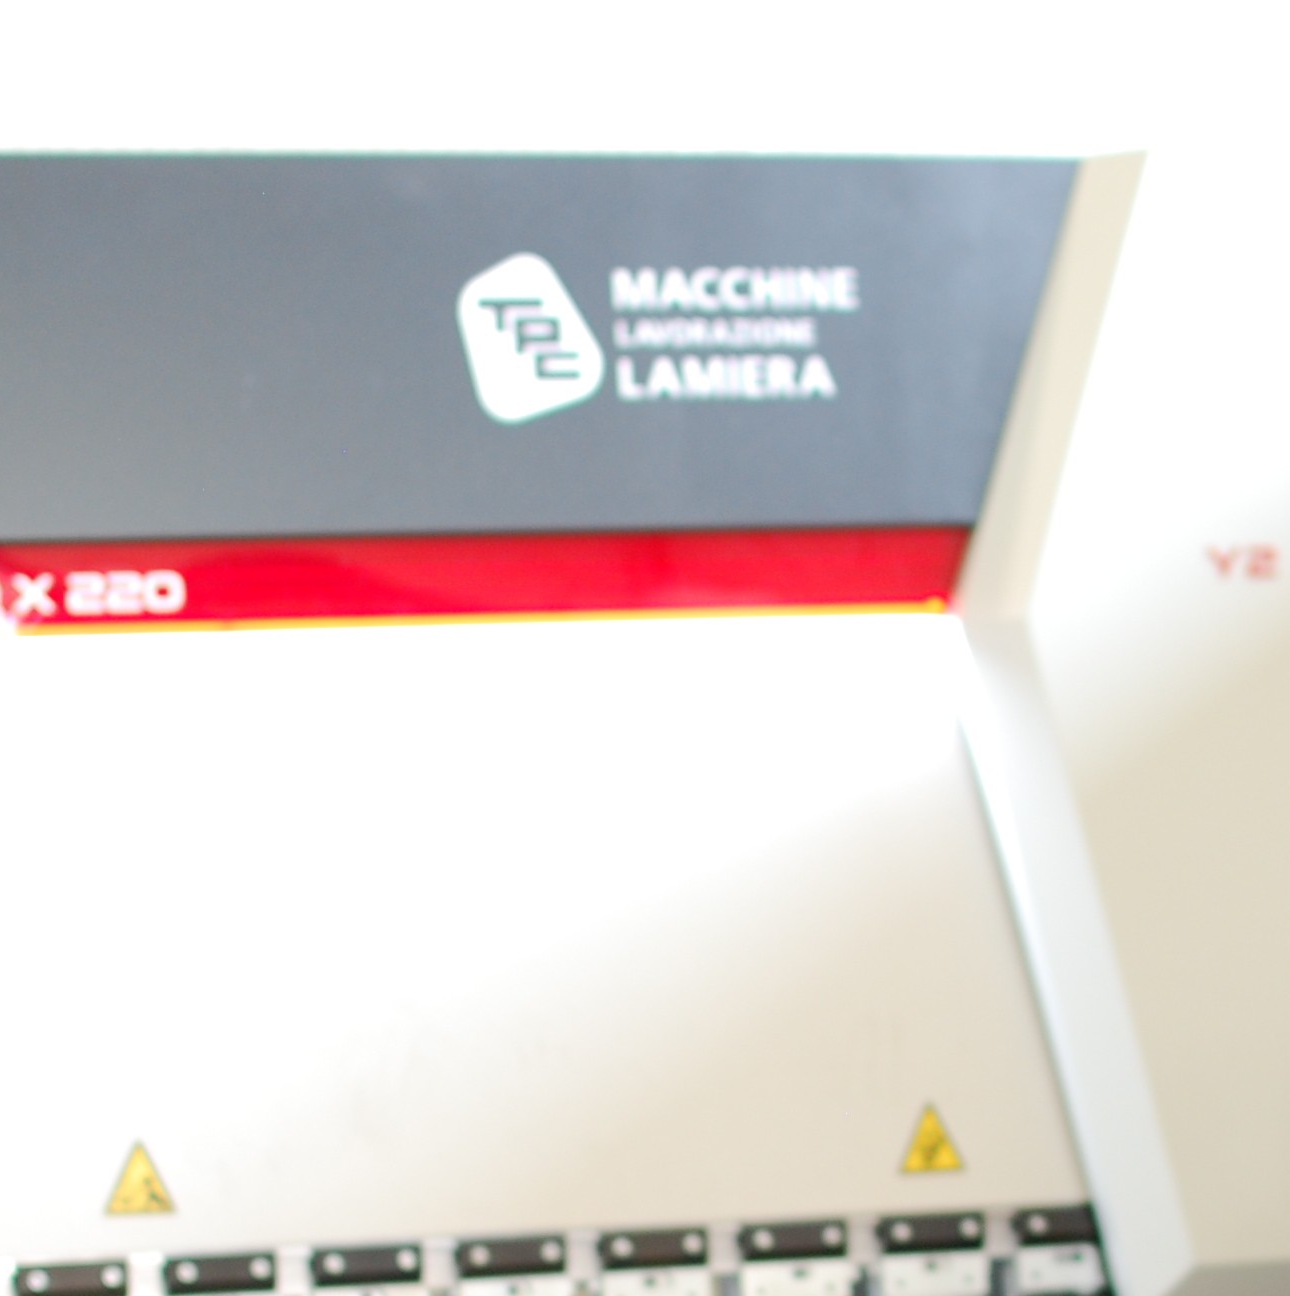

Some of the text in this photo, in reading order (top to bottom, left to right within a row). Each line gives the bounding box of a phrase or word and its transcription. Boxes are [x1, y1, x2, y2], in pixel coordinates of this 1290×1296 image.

[611, 267, 858, 311] MACCHINE
[478, 298, 580, 379] TPC
[617, 355, 836, 400] LAMIERA
[15, 574, 56, 615] X
[65, 570, 185, 614] 220
